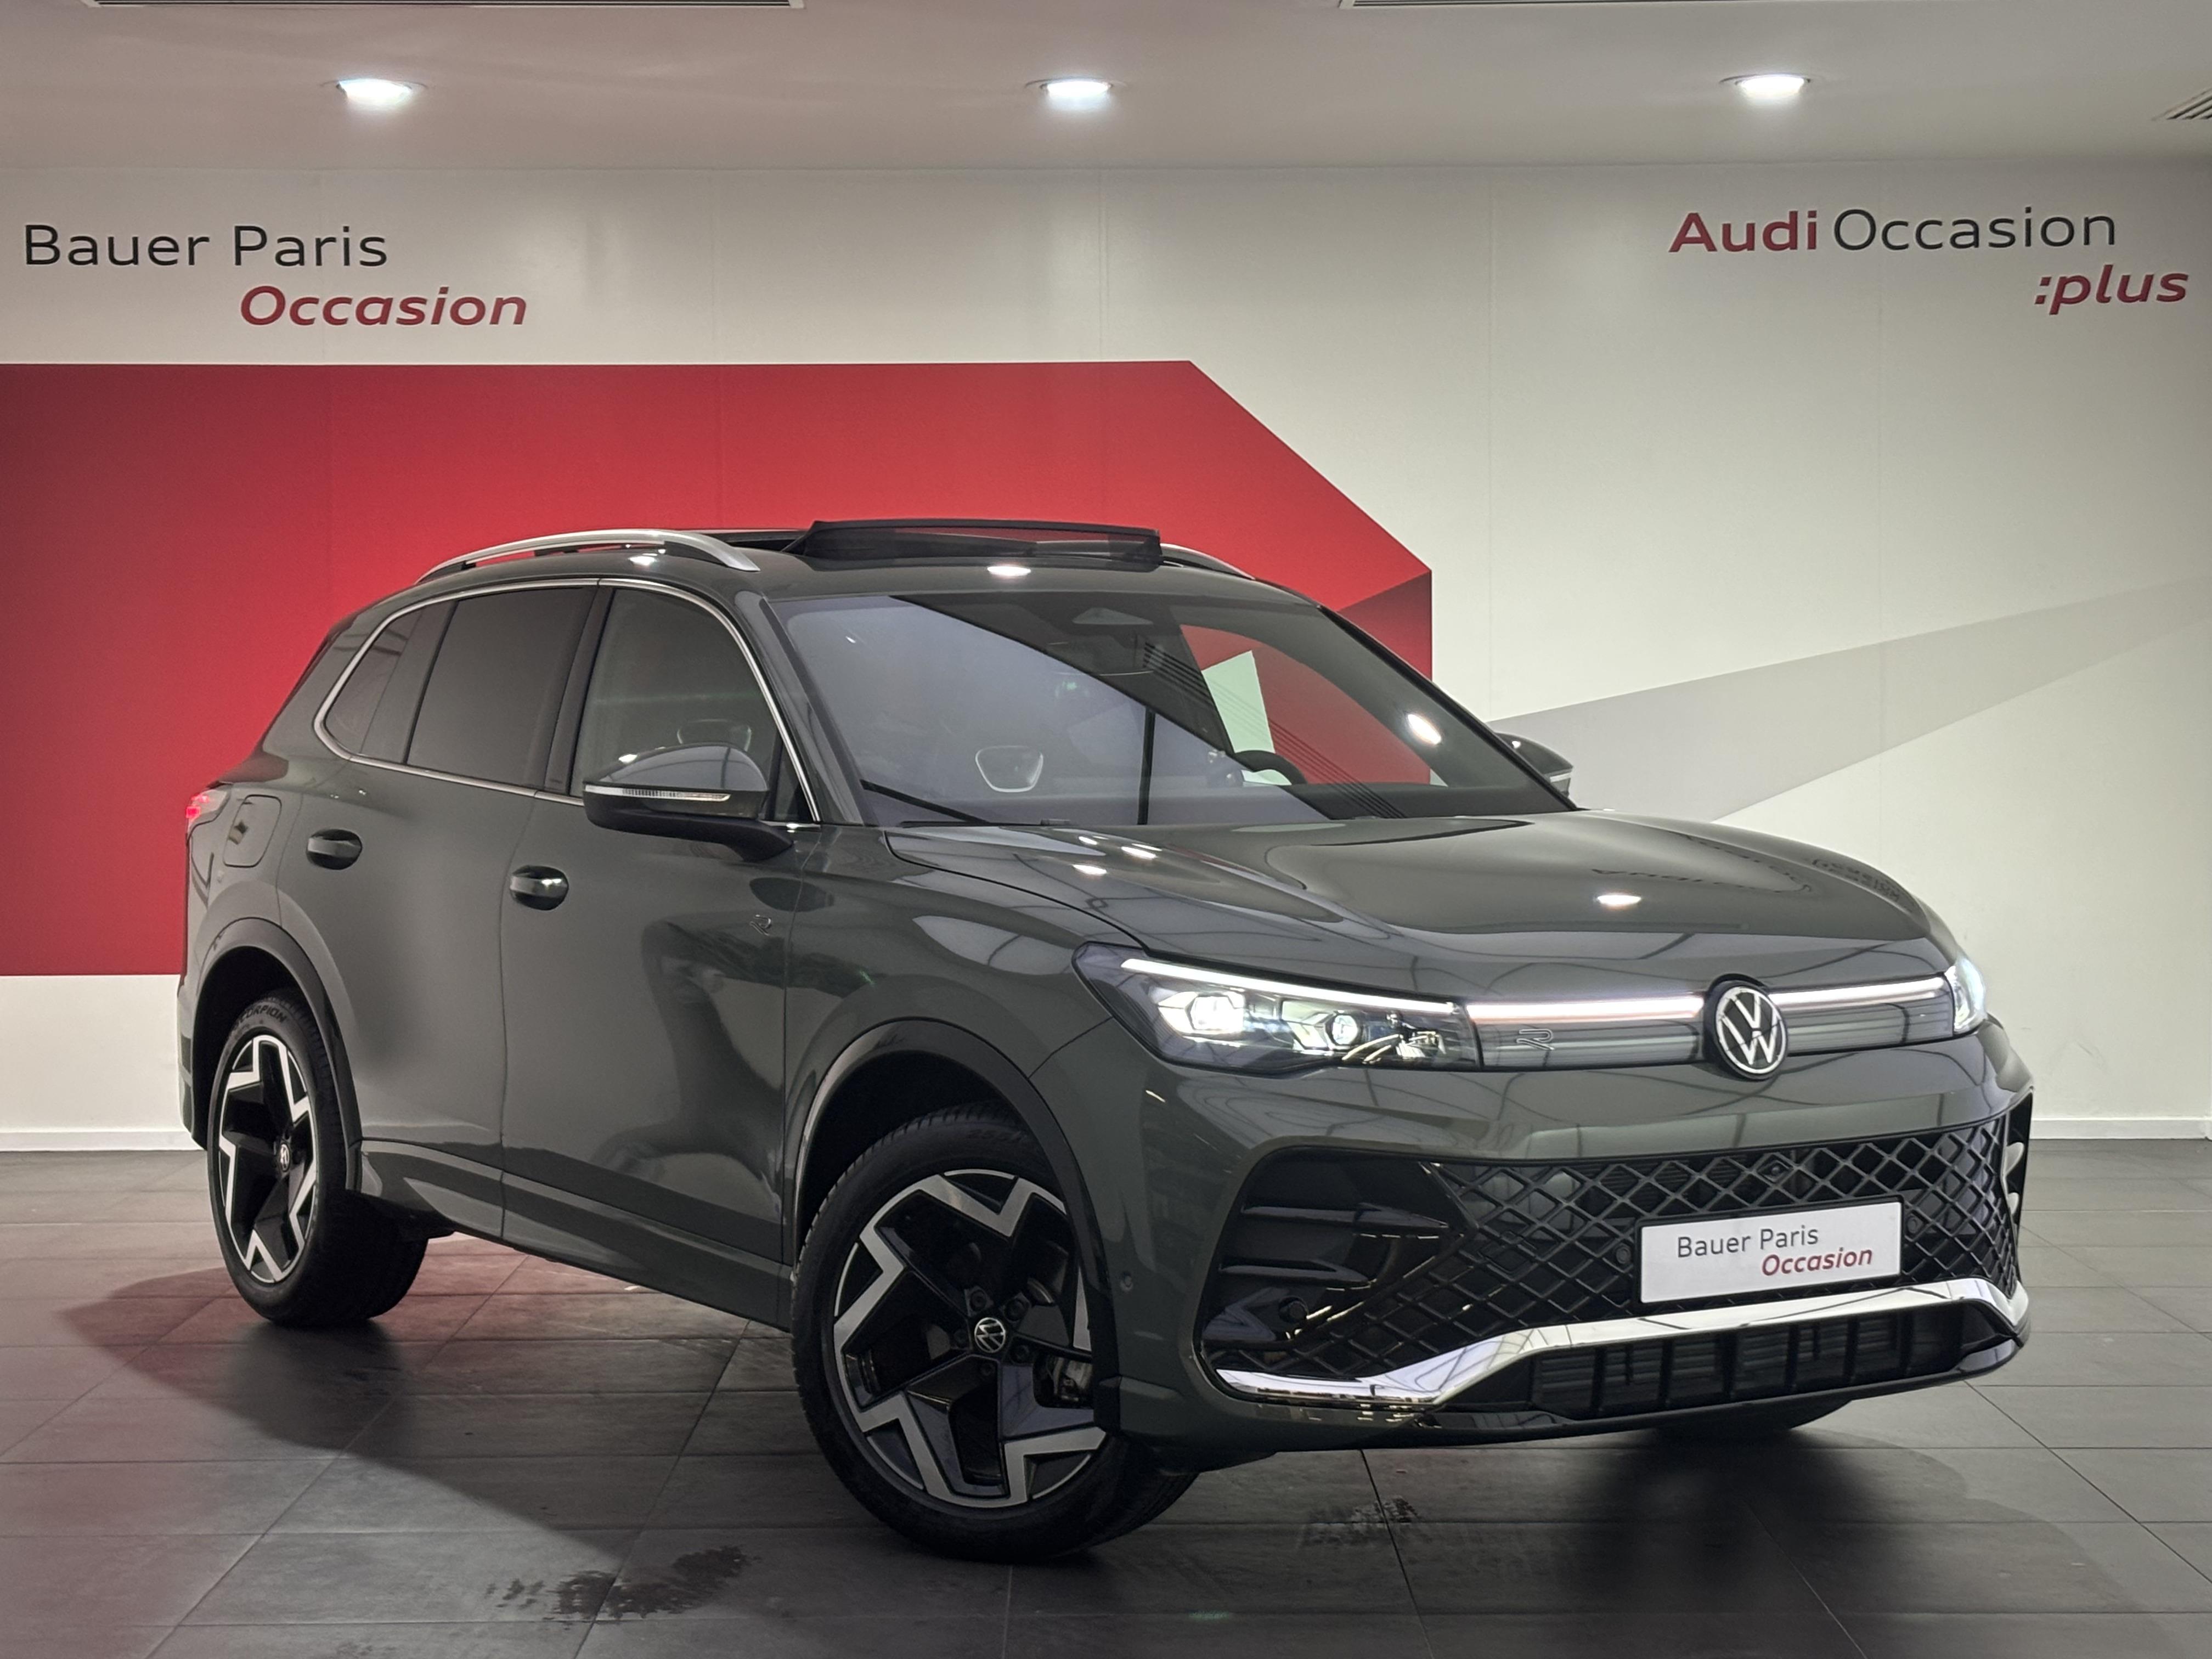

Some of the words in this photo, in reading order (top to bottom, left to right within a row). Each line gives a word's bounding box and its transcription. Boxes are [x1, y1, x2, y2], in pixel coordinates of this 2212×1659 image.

[26, 224, 211, 267] Bauer
[234, 225, 388, 268] Paris
[1669, 210, 1817, 252] Audi
[1833, 206, 2116, 251] Occasion
[240, 286, 527, 326] Occasion
[2034, 264, 2189, 315] :plus
[1677, 1235, 1752, 1259] Bauer
[1760, 1224, 1820, 1251] Paris
[1761, 1248, 1874, 1277] Occasion
